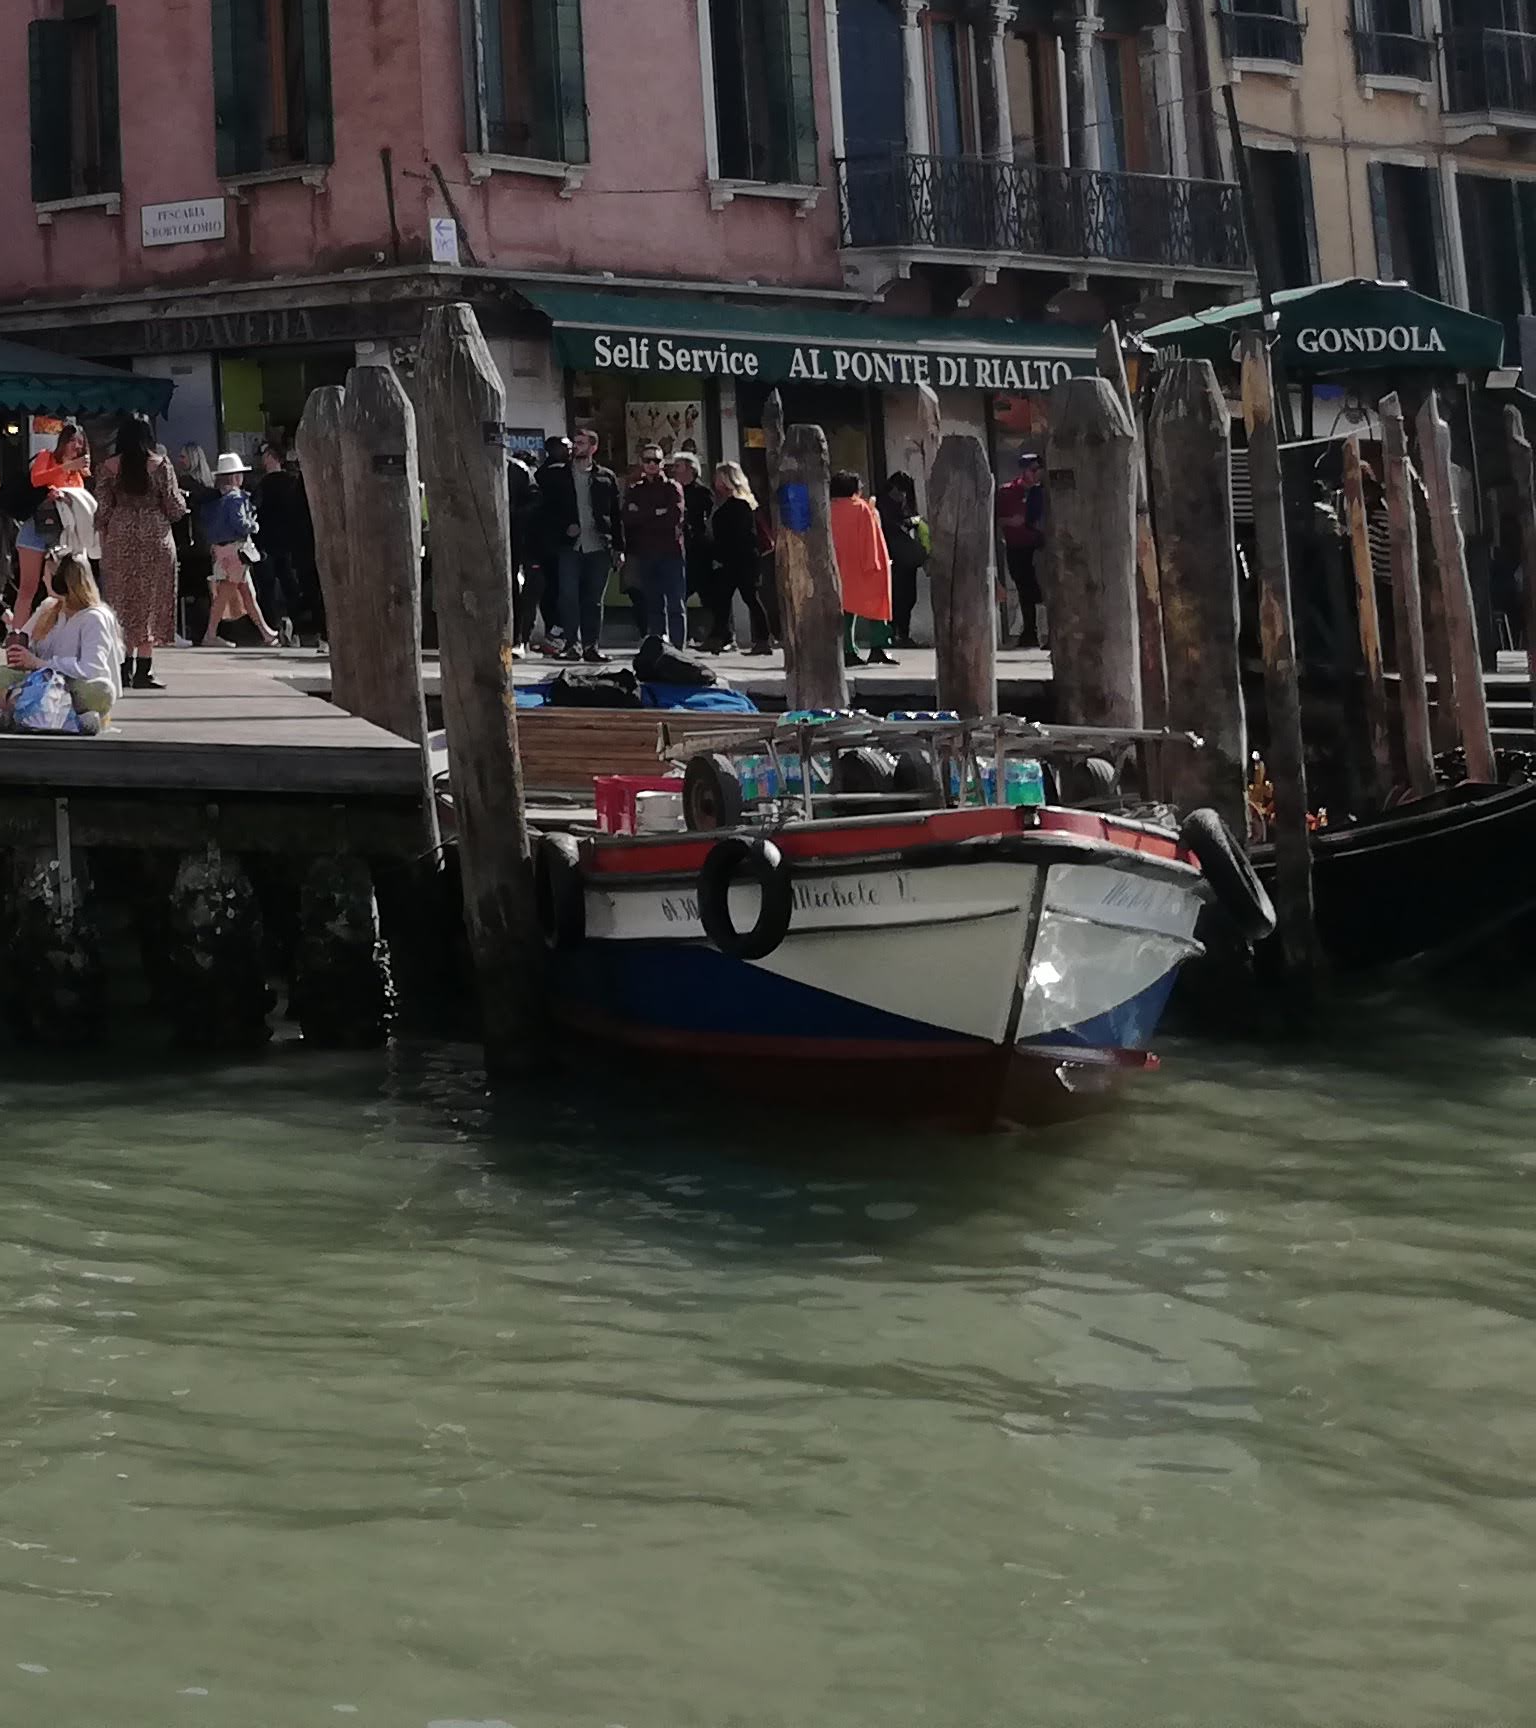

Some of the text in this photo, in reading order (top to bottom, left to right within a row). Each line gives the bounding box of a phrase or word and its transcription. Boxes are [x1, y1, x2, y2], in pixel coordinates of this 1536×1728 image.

[1296, 326, 1446, 354] GONDOLA
[594, 335, 1072, 390] Self Service AL PONTE DI RIALTO
